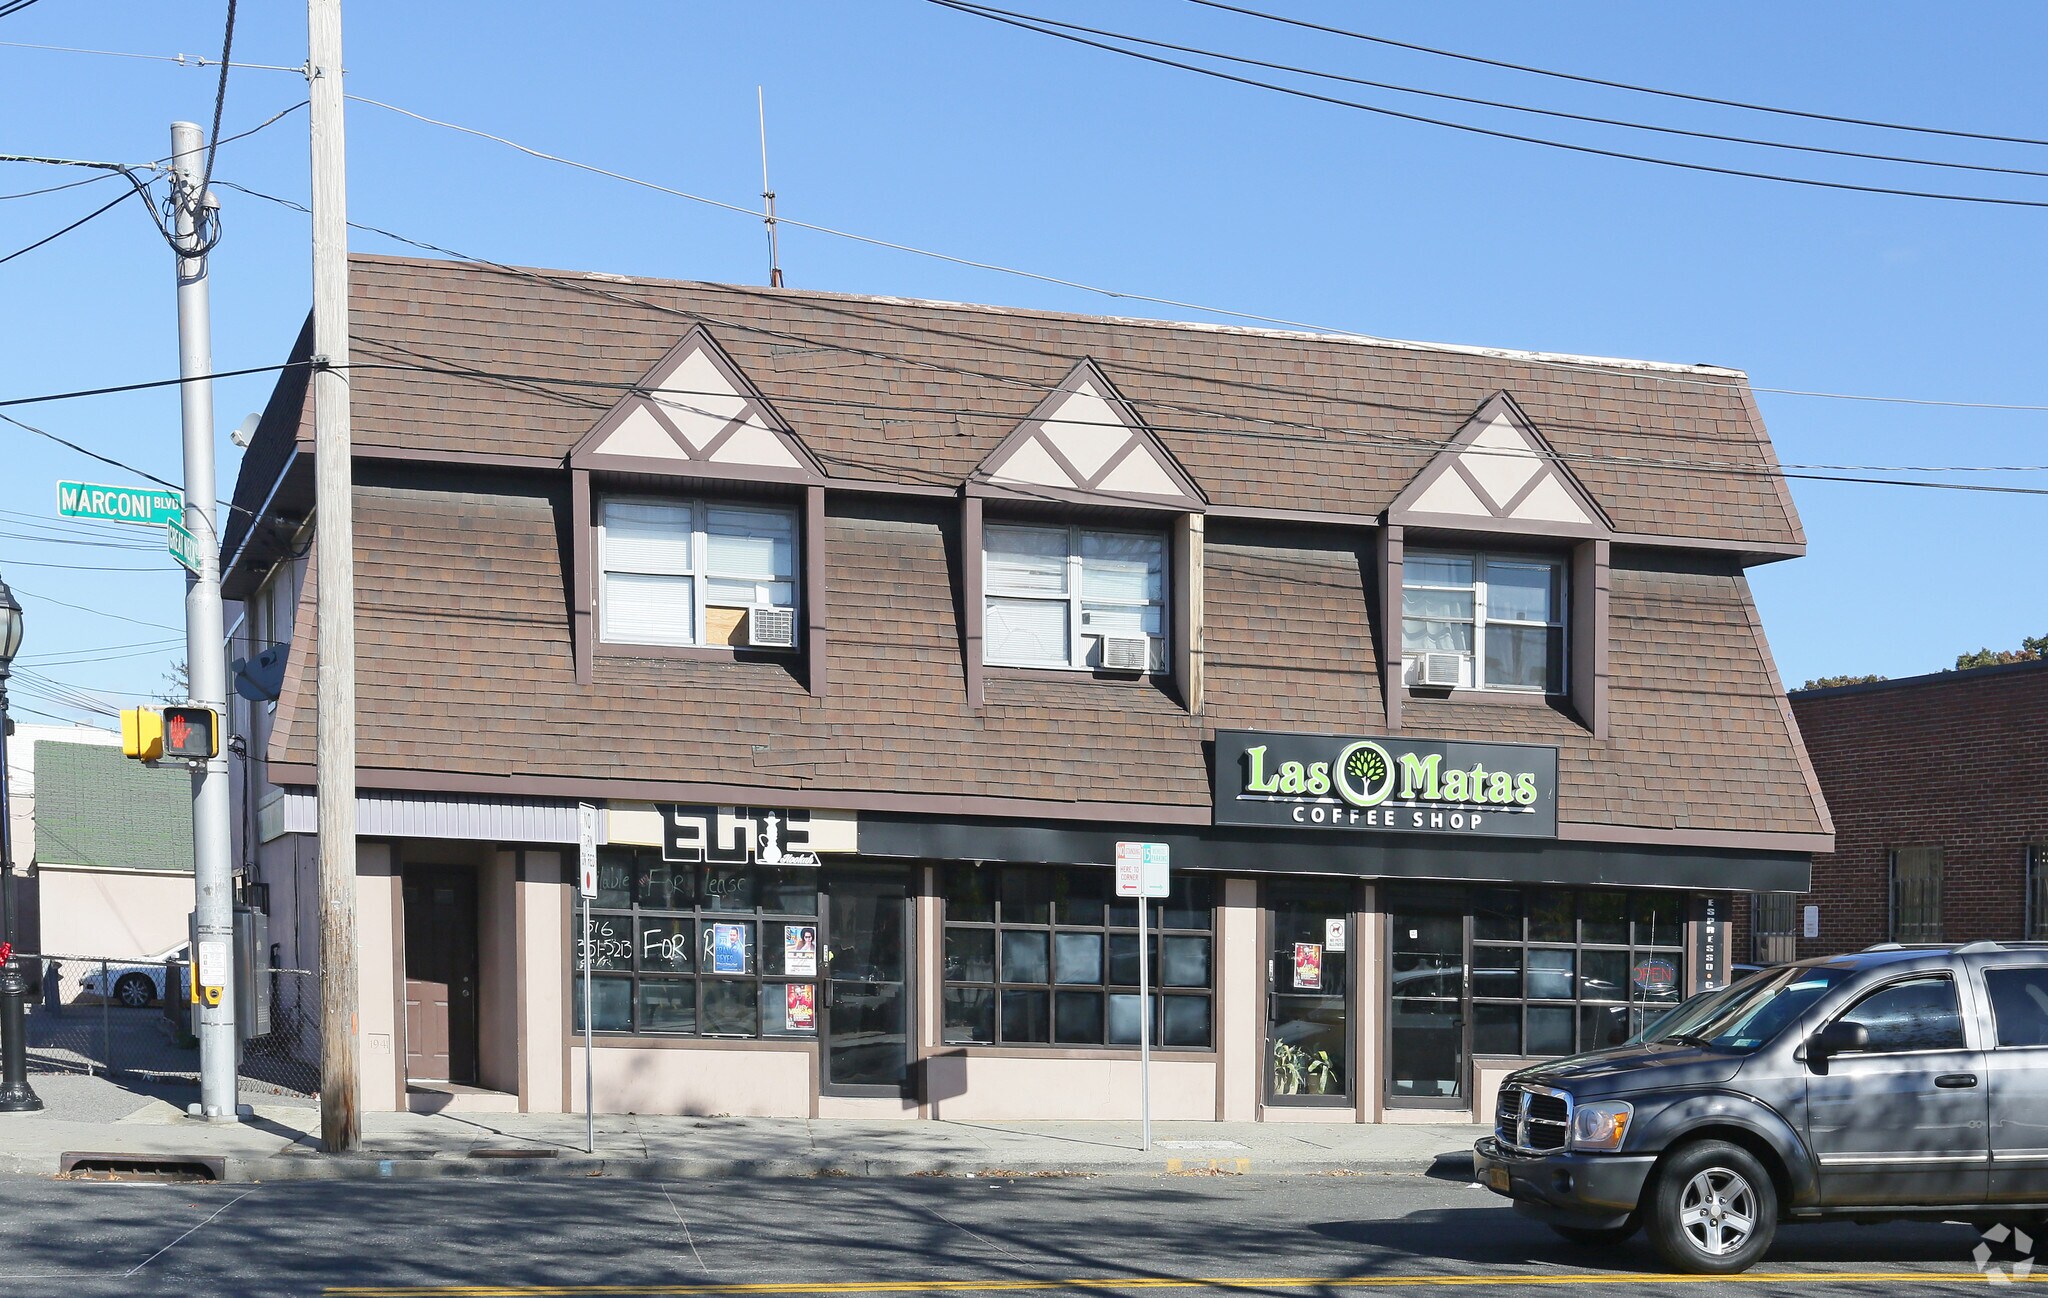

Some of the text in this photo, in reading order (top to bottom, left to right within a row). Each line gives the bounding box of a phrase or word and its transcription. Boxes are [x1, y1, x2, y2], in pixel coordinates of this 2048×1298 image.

[61, 487, 180, 518] MARCONI BLVD
[1246, 745, 1538, 805] Las Matas
[1292, 806, 1483, 830] COFFEE SHOP
[1633, 967, 1673, 982] OPEN
